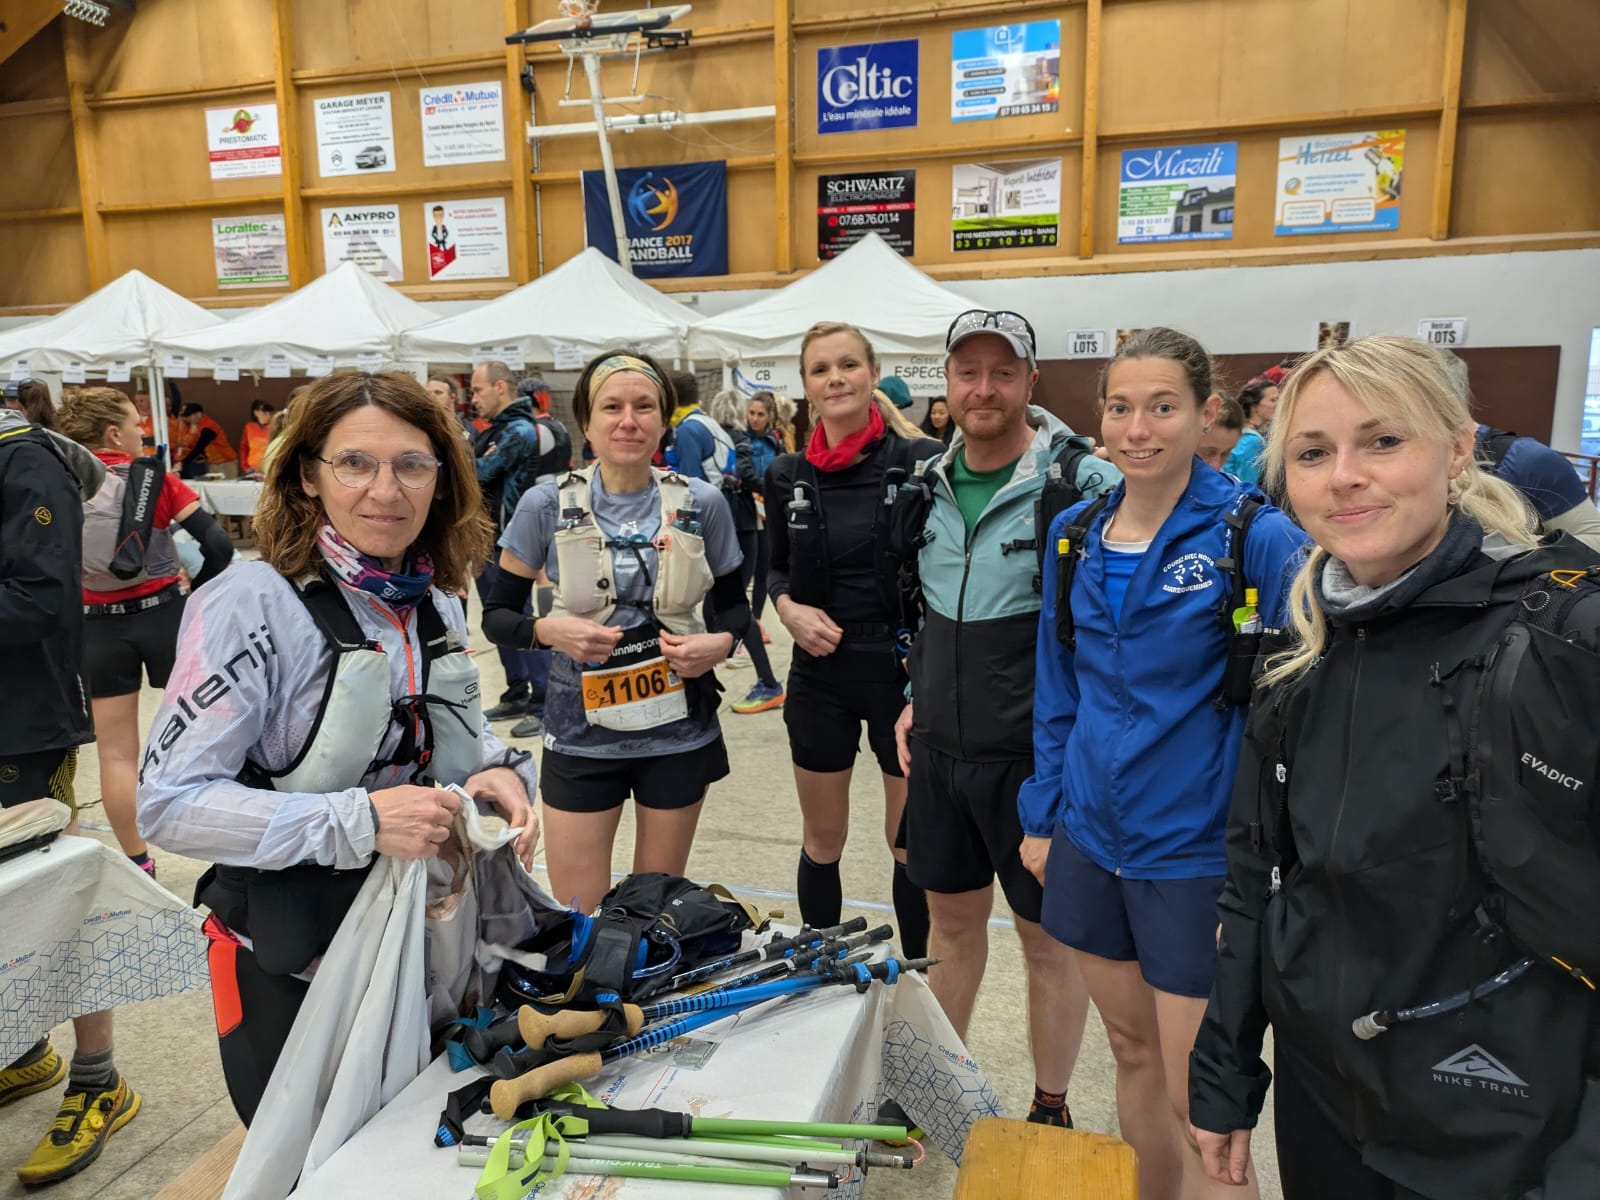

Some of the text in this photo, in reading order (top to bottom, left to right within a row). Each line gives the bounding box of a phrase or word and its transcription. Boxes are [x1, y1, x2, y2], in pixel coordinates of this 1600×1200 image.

[822, 56, 912, 108] Celtic
[320, 96, 385, 110] GARAGE MEYER
[424, 88, 498, 105] Crédit Mutuel
[822, 104, 912, 122] L'eau minérale idéale
[219, 134, 268, 144] PRESTOMATIC
[1126, 147, 1224, 179] Mazili
[826, 177, 905, 193] SCHWARTZ
[344, 211, 395, 222] ANYPRO
[217, 222, 268, 234] Loraltec
[628, 234, 693, 248] ANCE 2017
[629, 246, 693, 260] ANDBALL
[1428, 330, 1456, 344] LOTS
[1074, 341, 1098, 353] LOTS
[911, 355, 939, 364] Caisse
[755, 370, 770, 381] CB
[895, 366, 945, 379] ESPECE
[135, 468, 155, 522] SALOMON
[603, 669, 665, 704] 1106
[1520, 752, 1583, 791] EVADICT
[110, 909, 131, 918] Mutuel
[1432, 1073, 1529, 1098] NIKE TRAIL
